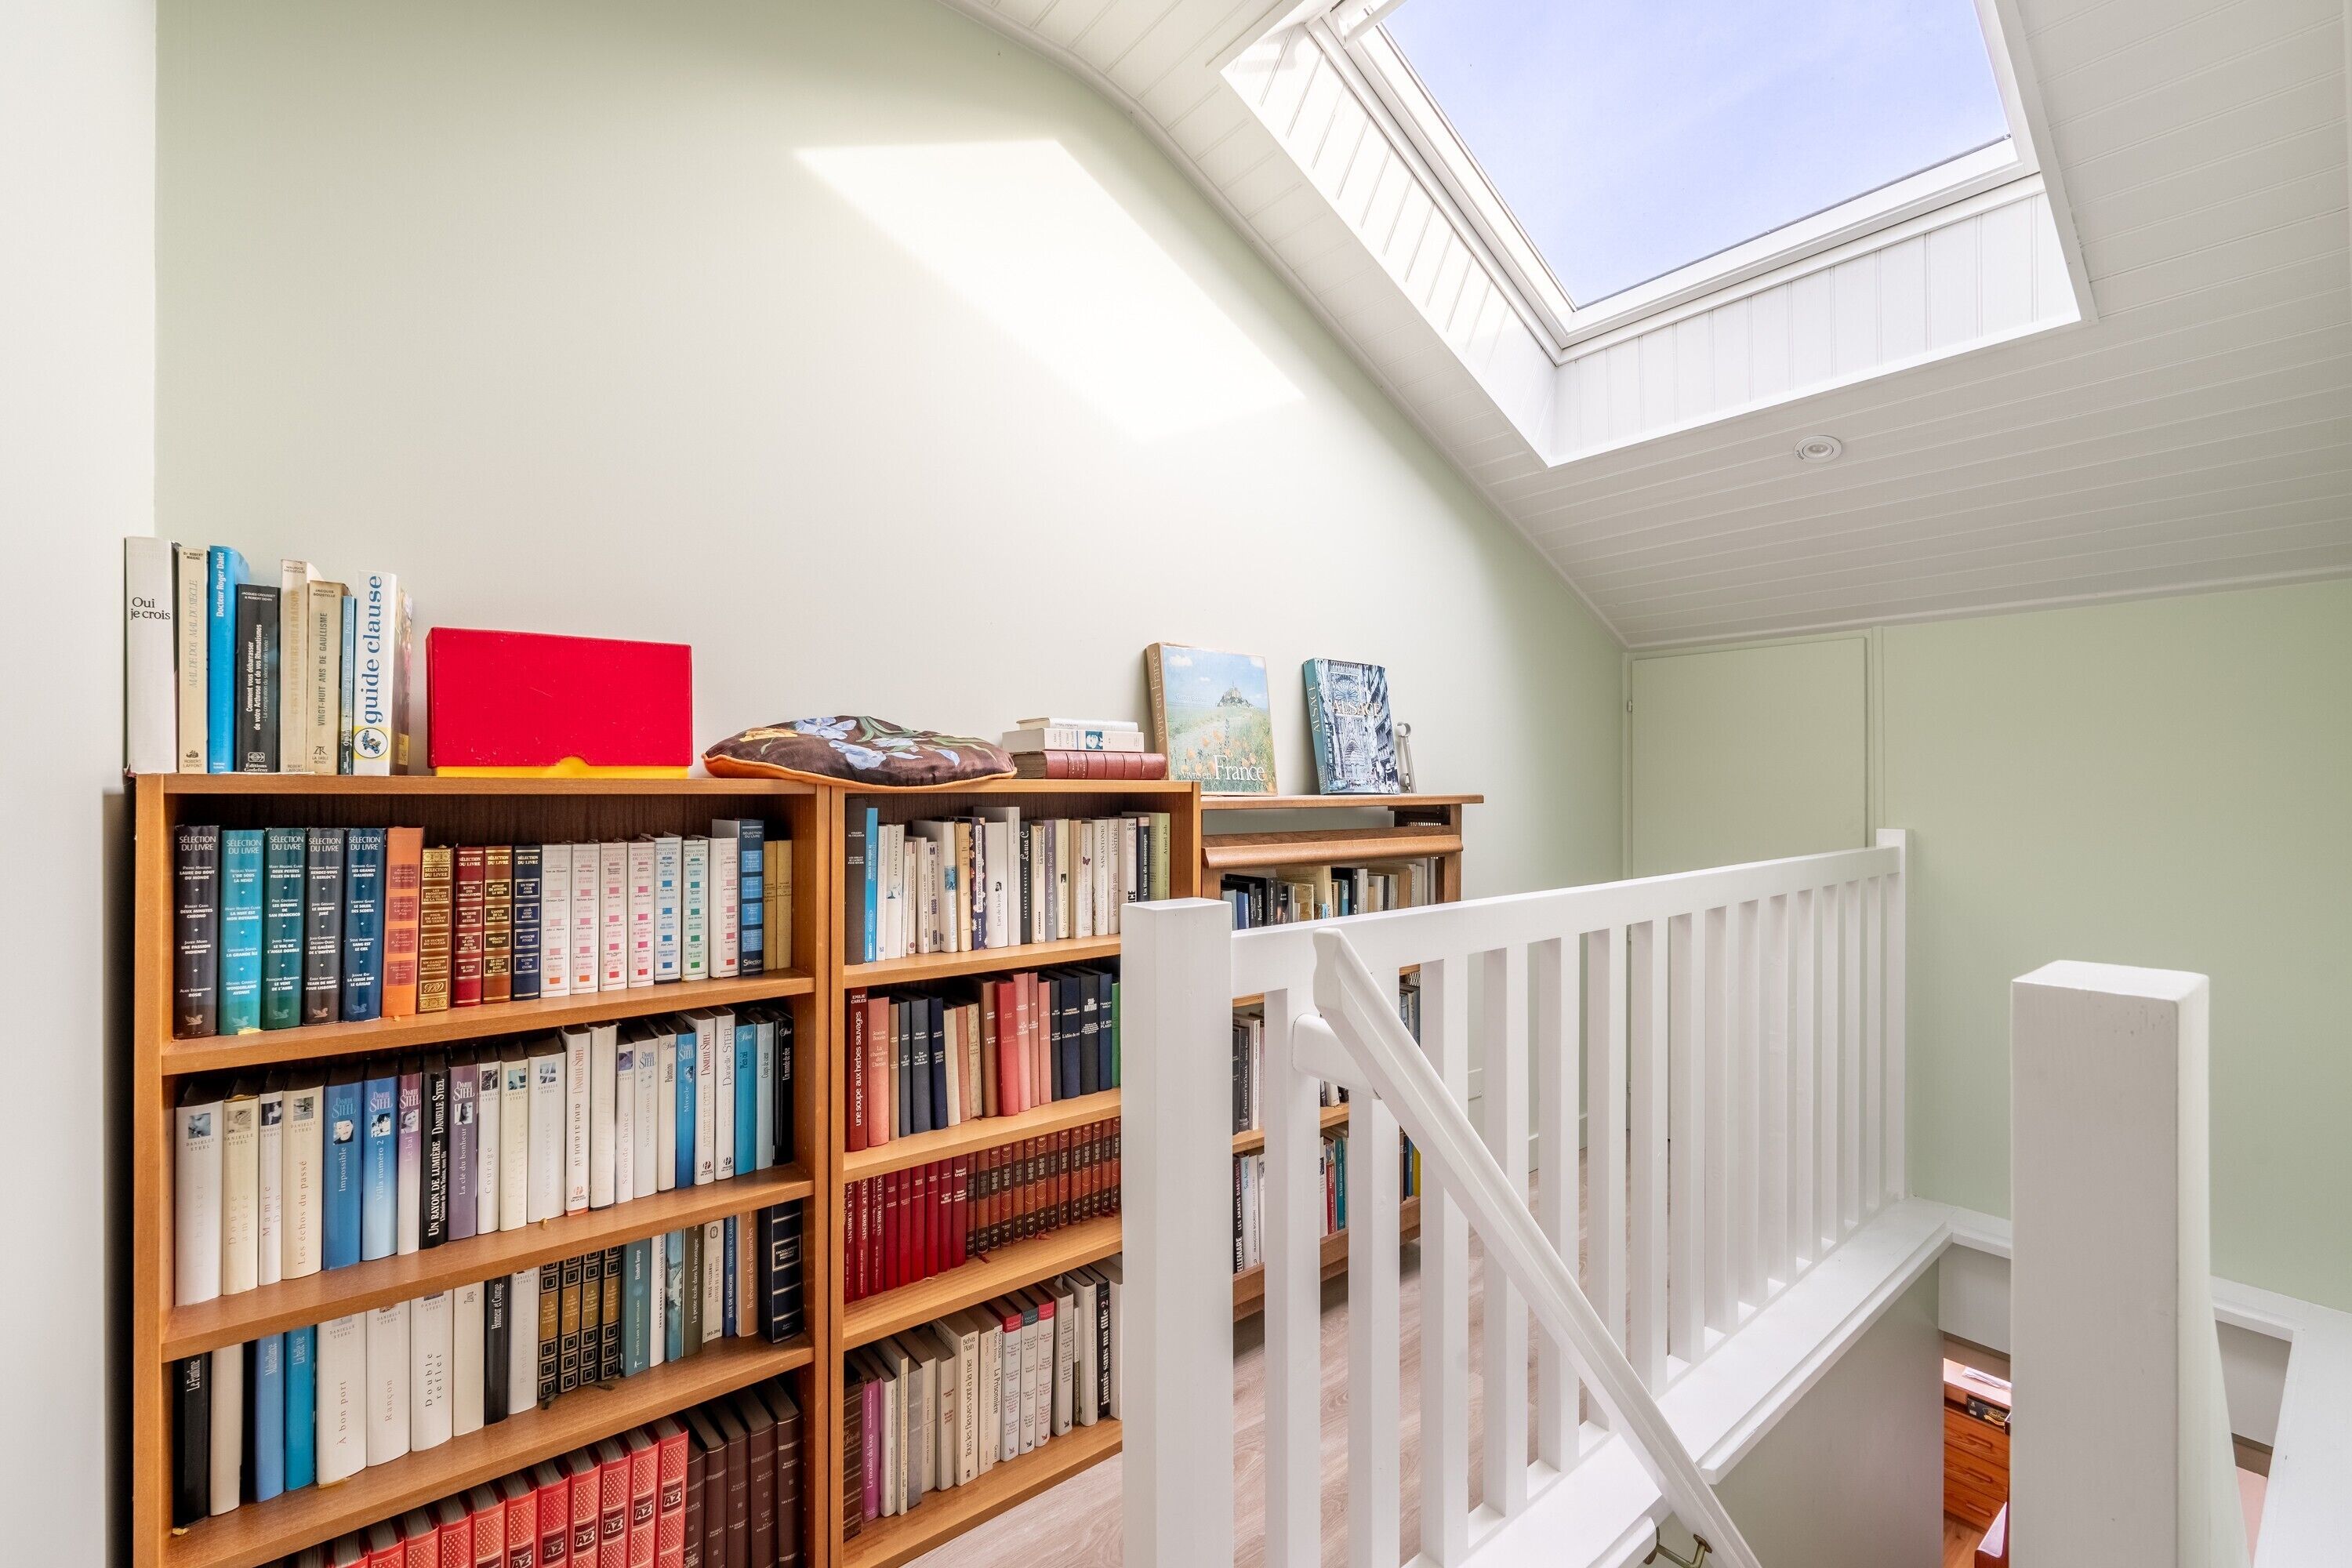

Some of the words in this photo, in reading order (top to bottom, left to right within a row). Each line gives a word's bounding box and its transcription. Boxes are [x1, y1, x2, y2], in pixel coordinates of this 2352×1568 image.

[216, 552, 225, 569] Dalet
[216, 571, 225, 590] Roger
[132, 597, 155, 608] Oui
[216, 592, 225, 618] Docteur
[129, 608, 141, 621] je
[142, 609, 171, 620] crois
[363, 575, 383, 653] clause
[254, 624, 263, 659] Rhumatismes
[319, 612, 328, 652] GAULLISME
[245, 641, 254, 673] débarrasser
[319, 655, 326, 665] DE
[1152, 652, 1162, 690] France
[363, 659, 383, 724] guide
[1156, 693, 1163, 709] en
[318, 686, 326, 727] VINGT-HUIT
[1308, 681, 1321, 733] ALSACE
[1331, 700, 1383, 717] ALSACE
[1156, 717, 1165, 743] vivre
[1212, 754, 1265, 782] France
[179, 835, 216, 844] SÉLECTION
[226, 839, 262, 848] SÉLECTION
[308, 837, 342, 845] SÉLECTION
[1020, 840, 1029, 862] Laura
[743, 958, 763, 967] Sélection
[699, 1032, 711, 1051] STEEL
[721, 1025, 732, 1054] STEEL
[665, 1063, 673, 1083] Palomino
[699, 1050, 710, 1076] DANIELLE
[721, 1054, 732, 1087] Danielle
[432, 1079, 445, 1101] STEEL
[432, 1101, 444, 1135] DANIELLE
[186, 1138, 216, 1146] DANIELLE
[430, 1140, 441, 1177] LUMIÈRE
[459, 1160, 466, 1169] du
[299, 1160, 308, 1190] passé
[338, 1147, 347, 1192] Impossible
[485, 1147, 494, 1194] Courage
[431, 1179, 441, 1191] DE
[459, 1185, 466, 1196] La
[298, 1193, 307, 1207] du
[430, 1193, 441, 1220] RAYON
[228, 1194, 238, 1245] Douce
[297, 1210, 307, 1243] échos
[428, 1222, 440, 1236] UN
[297, 1245, 307, 1265] Les
[492, 1283, 504, 1303] Courage
[1100, 1299, 1109, 1308] 2
[491, 1308, 503, 1330] Honneur
[1101, 1308, 1109, 1329] fille
[328, 1324, 356, 1334] DANIELLE
[332, 1330, 351, 1339] STEEL
[1102, 1330, 1109, 1347] ma
[963, 1336, 976, 1345] Belva
[424, 1352, 434, 1407] Double
[1101, 1372, 1109, 1406] jamais
[339, 1380, 350, 1406] port
[384, 1379, 394, 1422] Rançon
[338, 1410, 347, 1432] bon
[336, 1436, 347, 1446] À
[867, 1450, 873, 1458] du
[867, 1480, 874, 1489] Le
[663, 1492, 681, 1507] AZ
[634, 1504, 653, 1520] AZ
[604, 1519, 624, 1534] AZ
[575, 1531, 595, 1547] AZ
[544, 1541, 564, 1558] AZ
